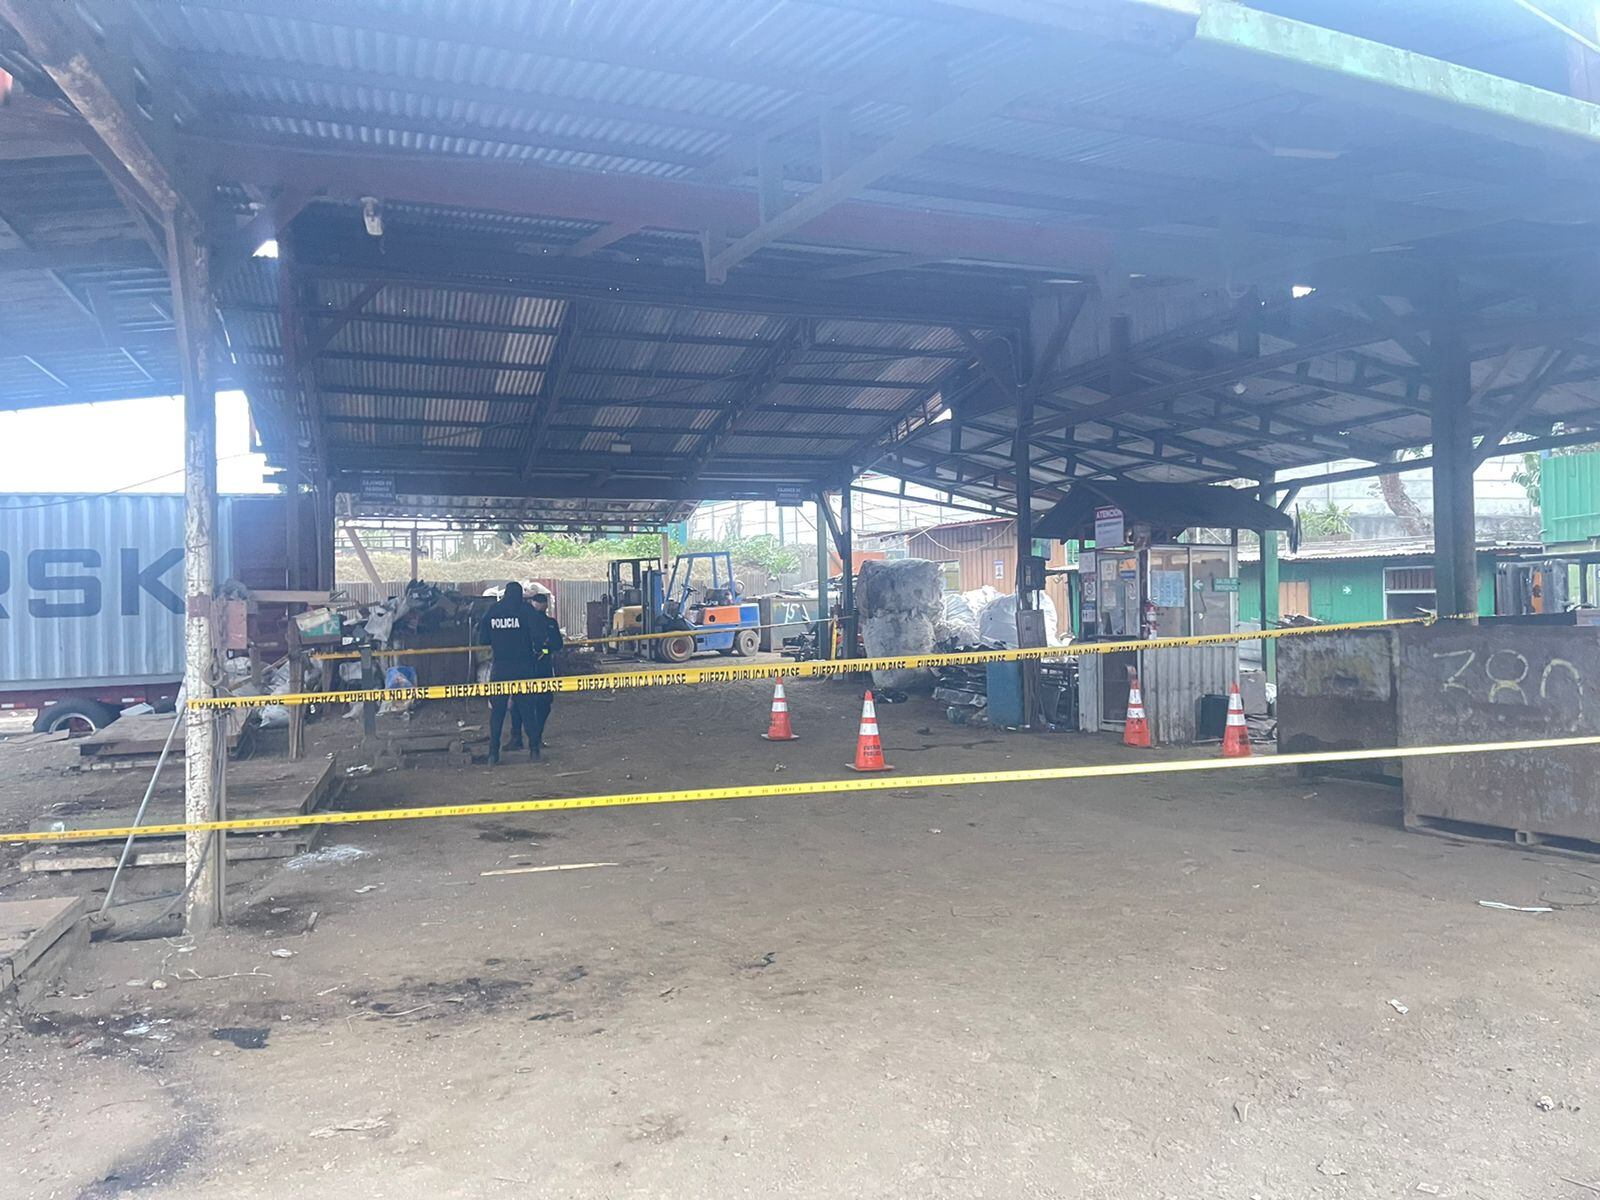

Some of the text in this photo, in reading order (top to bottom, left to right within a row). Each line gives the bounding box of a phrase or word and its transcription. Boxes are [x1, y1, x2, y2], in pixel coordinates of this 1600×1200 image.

[0, 547, 185, 618] SK
[491, 618, 520, 629] POLICIA
[344, 690, 385, 703] PUBLICA
[406, 687, 430, 699] PASE
[445, 685, 480, 698] FUERZA
[484, 682, 522, 695] PUBLICA
[542, 680, 563, 692] PASE
